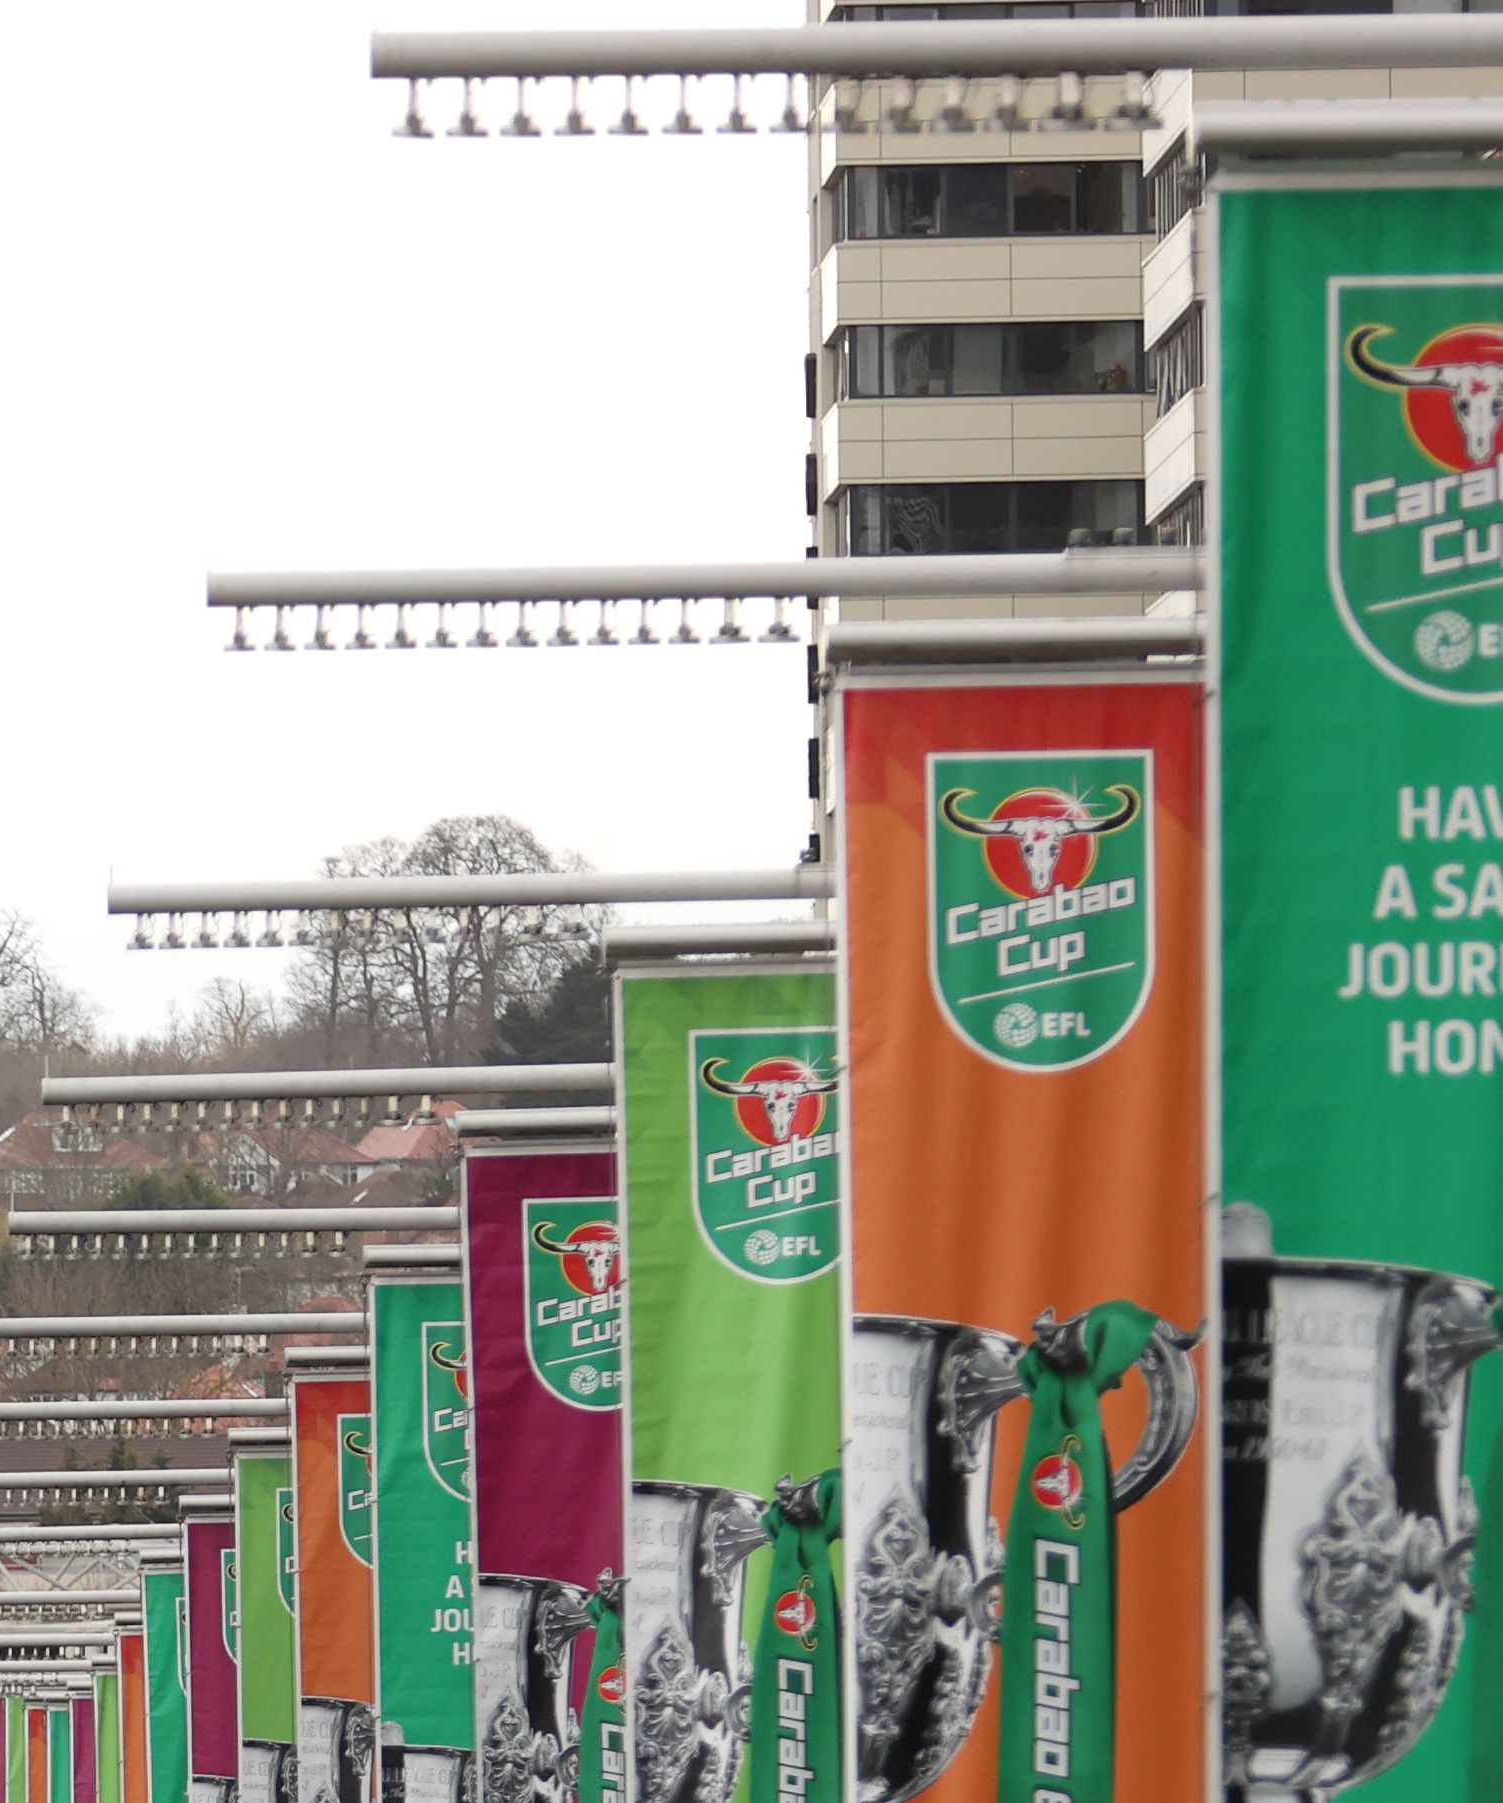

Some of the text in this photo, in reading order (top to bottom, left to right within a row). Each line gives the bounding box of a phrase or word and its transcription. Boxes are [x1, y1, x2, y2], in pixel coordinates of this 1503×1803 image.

[1352, 462, 1503, 535] Cara
[1420, 514, 1503, 577] Cu
[945, 876, 1136, 946] Carabao
[1374, 862, 1503, 920] A SA
[997, 930, 1086, 978] Cup
[1042, 1011, 1092, 1038] EFL
[706, 1131, 843, 1185] Caraba
[746, 1170, 816, 1209] Cup
[782, 1236, 821, 1257] EFL
[601, 1371, 624, 1387] EF
[446, 1575, 465, 1599] A
[1031, 1536, 1081, 1779] Carabao
